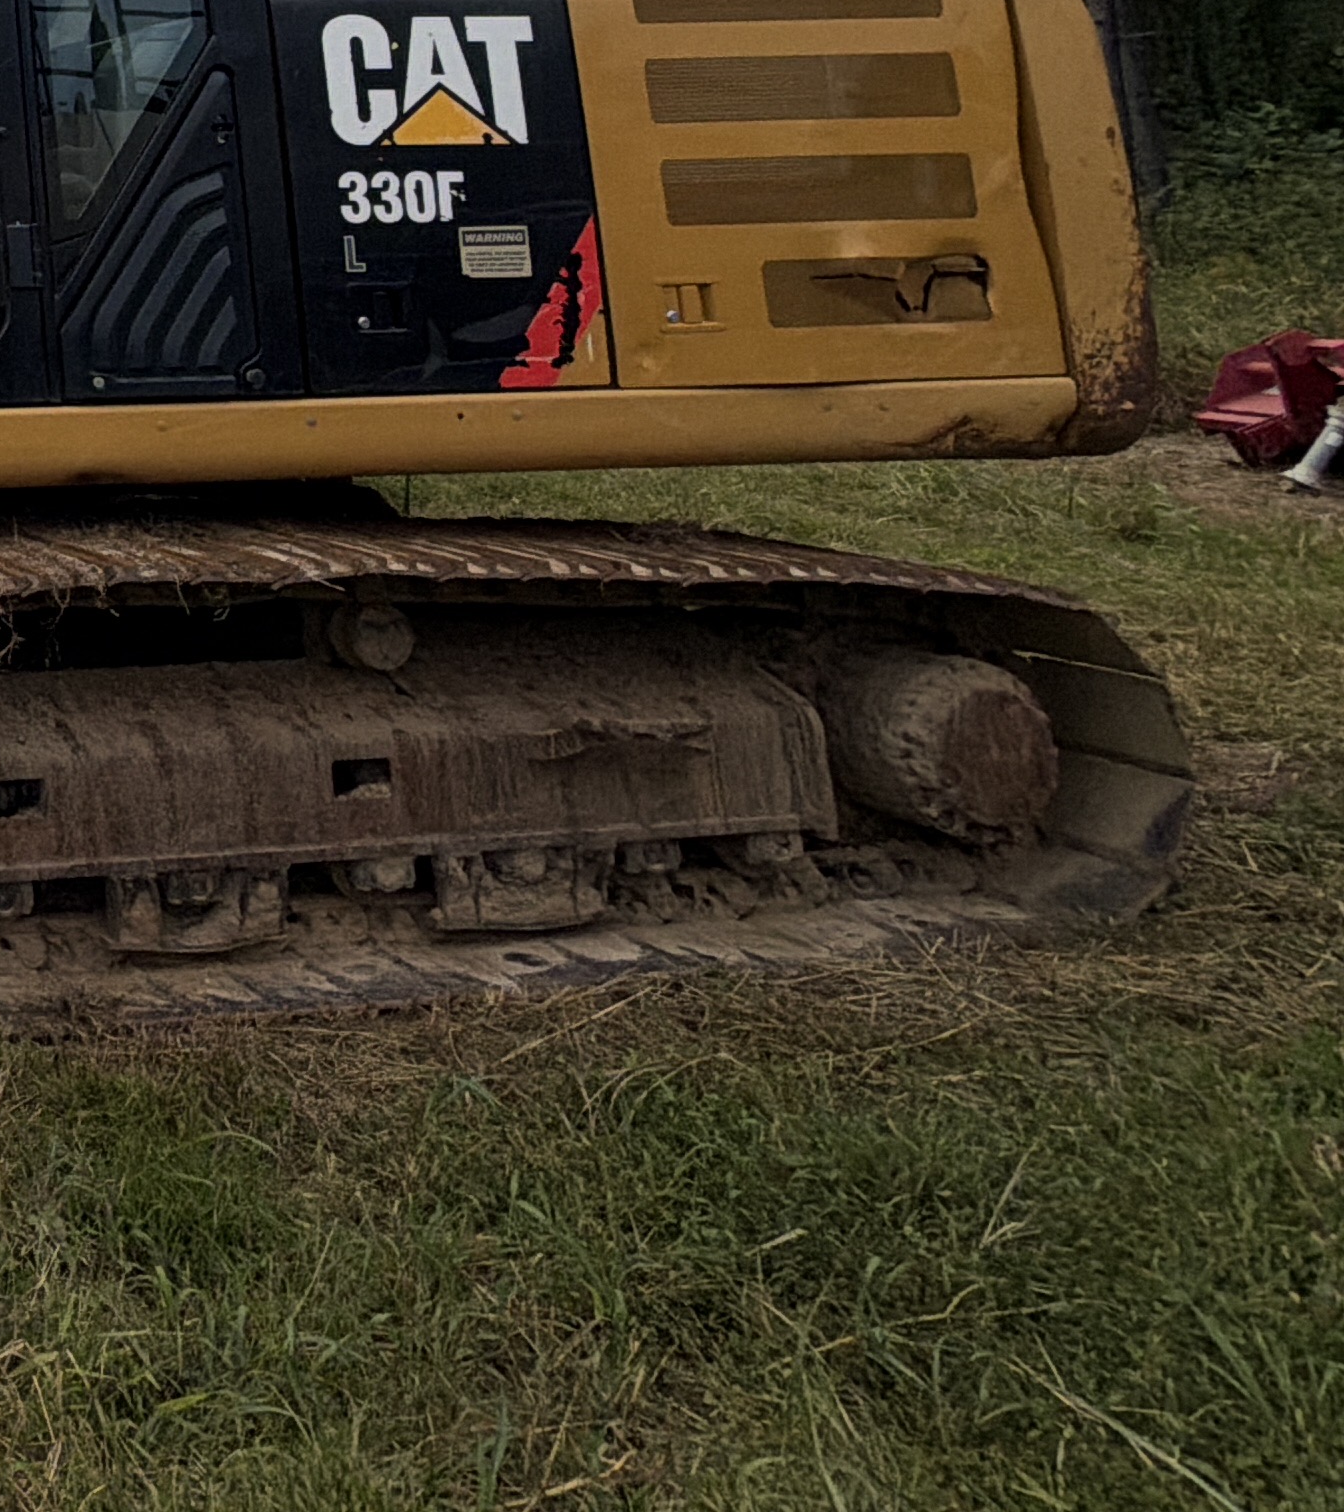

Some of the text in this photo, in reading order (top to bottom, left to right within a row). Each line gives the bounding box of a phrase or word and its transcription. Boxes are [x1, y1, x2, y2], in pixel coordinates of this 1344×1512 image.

[322, 14, 534, 146] CAT
[338, 171, 466, 224] 330F
[343, 235, 367, 273] L
[464, 231, 525, 244] WARNING
